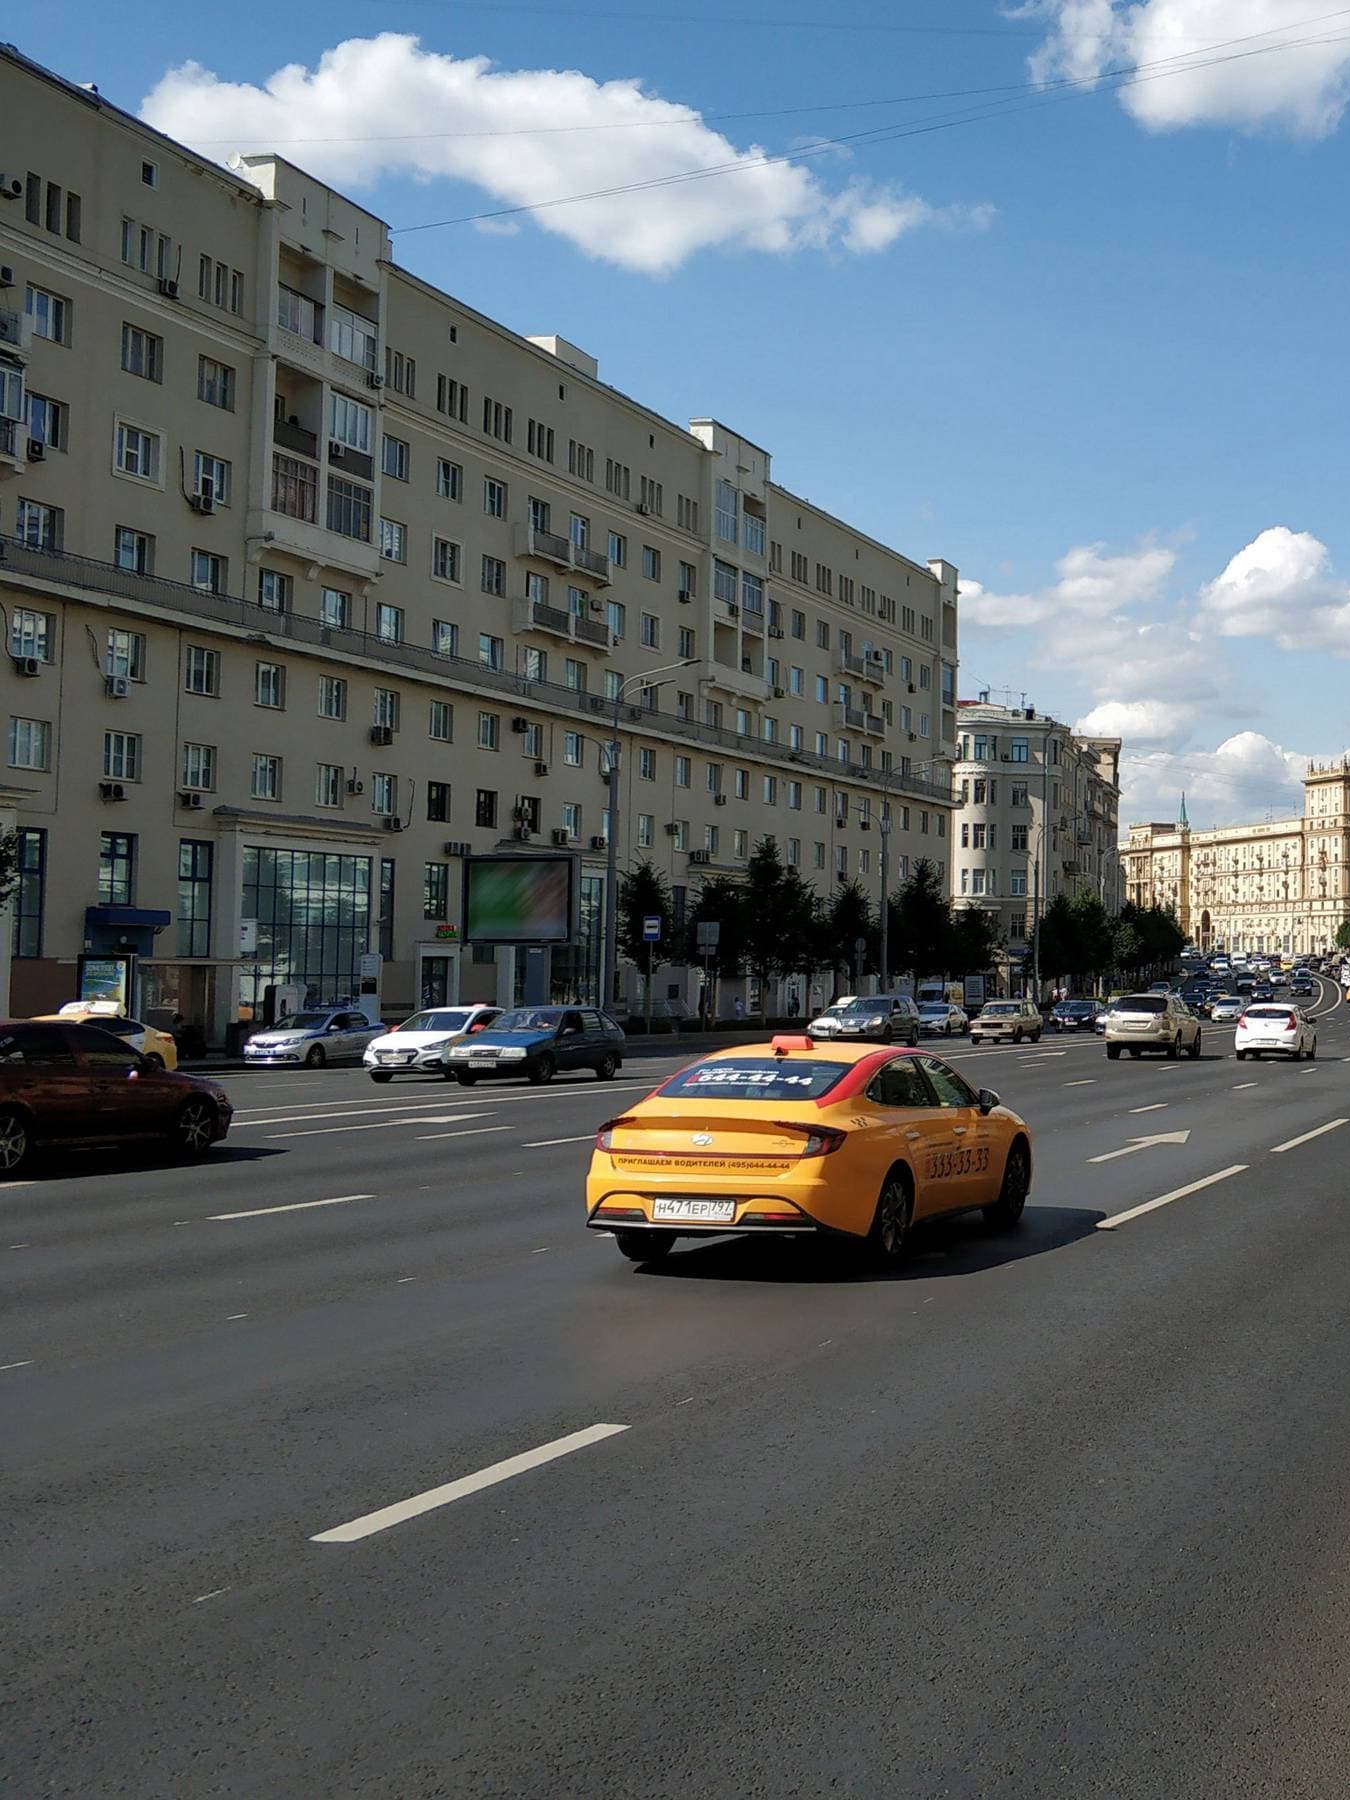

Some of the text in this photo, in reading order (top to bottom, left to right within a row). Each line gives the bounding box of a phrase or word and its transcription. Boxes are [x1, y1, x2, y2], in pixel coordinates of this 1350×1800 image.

[697, 1073, 813, 1086] 644-44-44
[618, 1157, 672, 1166] ПРИГЛАШАЕМ
[674, 1159, 726, 1168] ВОДИТЕЛЕЙ
[657, 1200, 731, 1215] Н471ЕР 797
